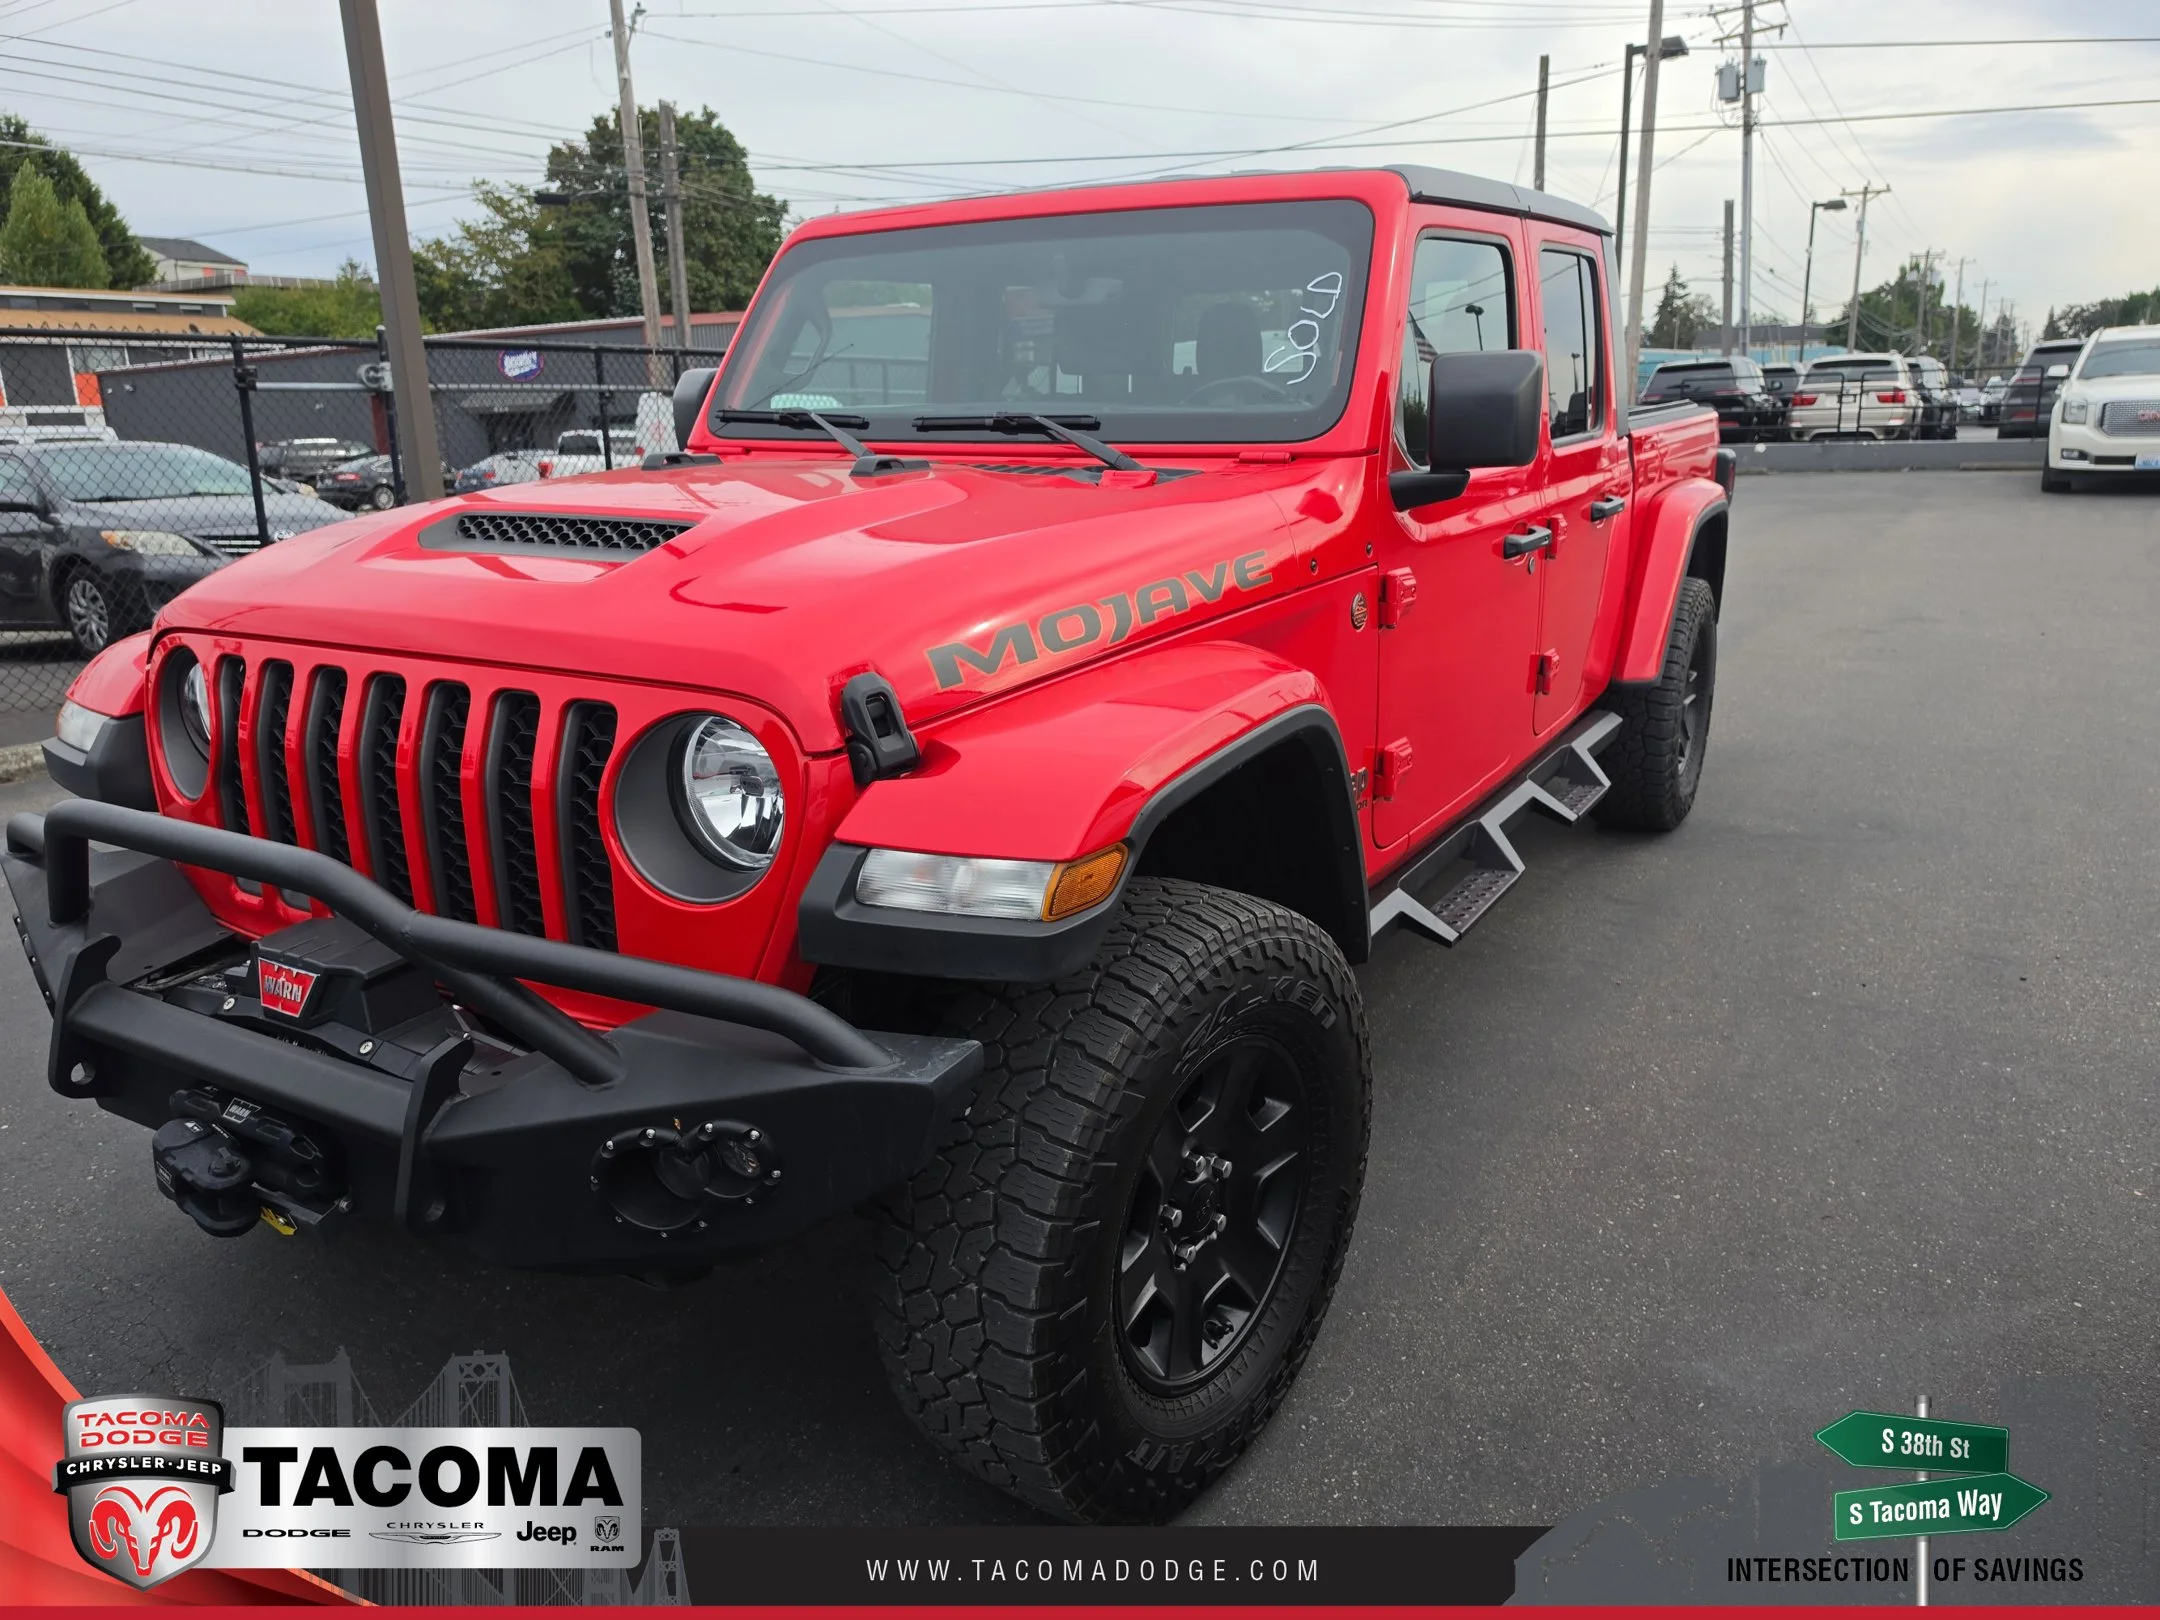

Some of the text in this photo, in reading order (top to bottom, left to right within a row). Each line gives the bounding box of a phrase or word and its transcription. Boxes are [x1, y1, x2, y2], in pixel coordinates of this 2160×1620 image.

[1264, 272, 1342, 385] SOLD
[924, 549, 1274, 692] MOJAVE
[264, 974, 303, 1003] WARN
